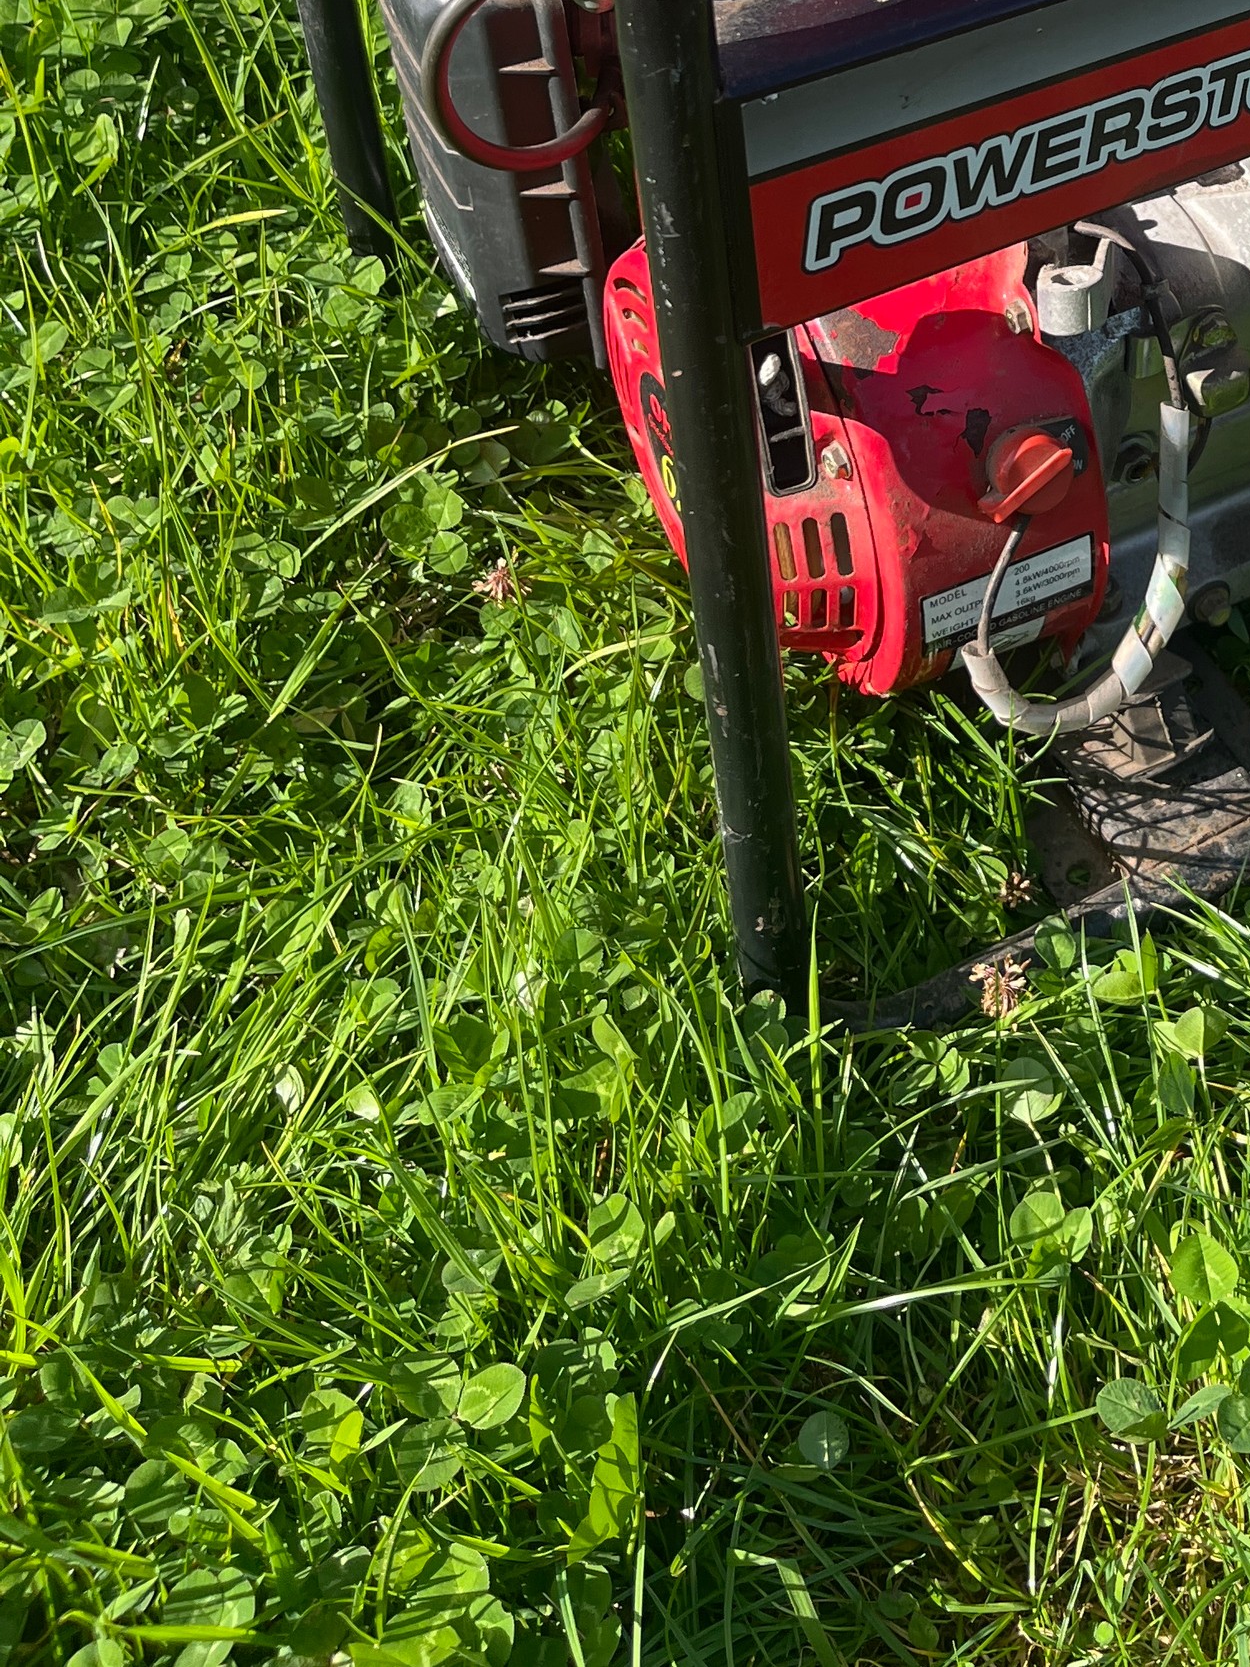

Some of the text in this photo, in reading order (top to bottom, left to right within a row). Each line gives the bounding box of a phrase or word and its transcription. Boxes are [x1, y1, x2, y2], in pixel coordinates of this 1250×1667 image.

[929, 563, 1030, 608] MODEL 200
[931, 610, 953, 625] MAX
[955, 599, 984, 616] OUTP
[1000, 604, 1046, 627] GASOLINE
[1047, 588, 1083, 608] ENGINE
